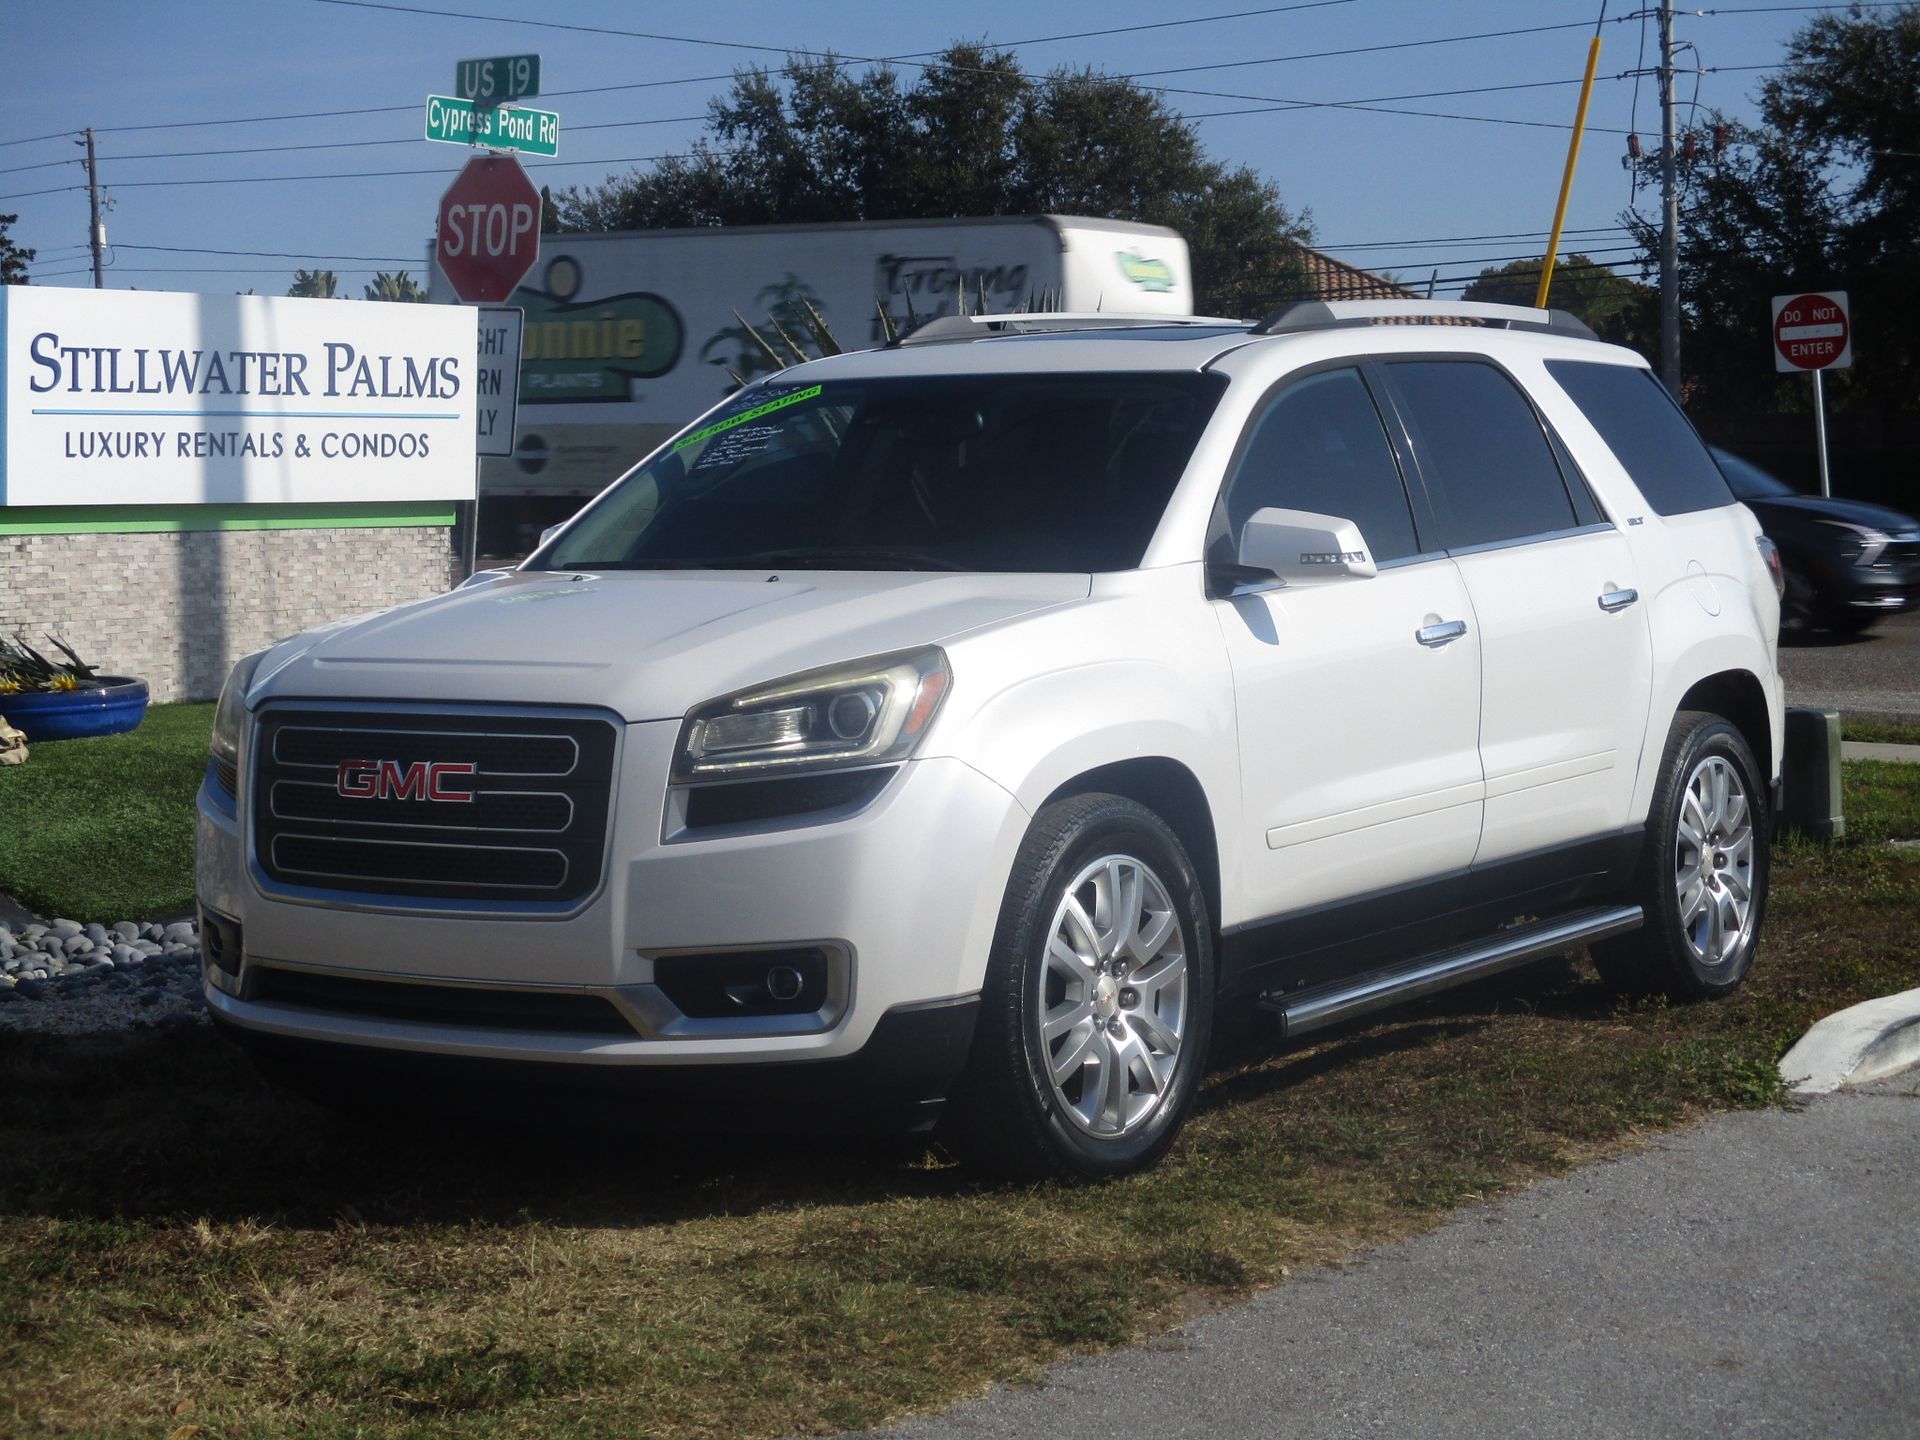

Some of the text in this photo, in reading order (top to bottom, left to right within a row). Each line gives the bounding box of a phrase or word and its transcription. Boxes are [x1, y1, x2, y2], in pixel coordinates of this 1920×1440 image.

[465, 58, 530, 98] US 19
[429, 100, 556, 144] Cypress Pond Rd
[444, 203, 533, 257] STOP
[1784, 307, 1837, 323] DO NOT
[1791, 342, 1834, 356] ENTER
[477, 368, 502, 396] RN
[752, 387, 819, 414] SEATING
[477, 408, 498, 436] LY
[65, 431, 429, 458] LUXURY RENTALS & CONDOS
[336, 758, 477, 803] GMC
